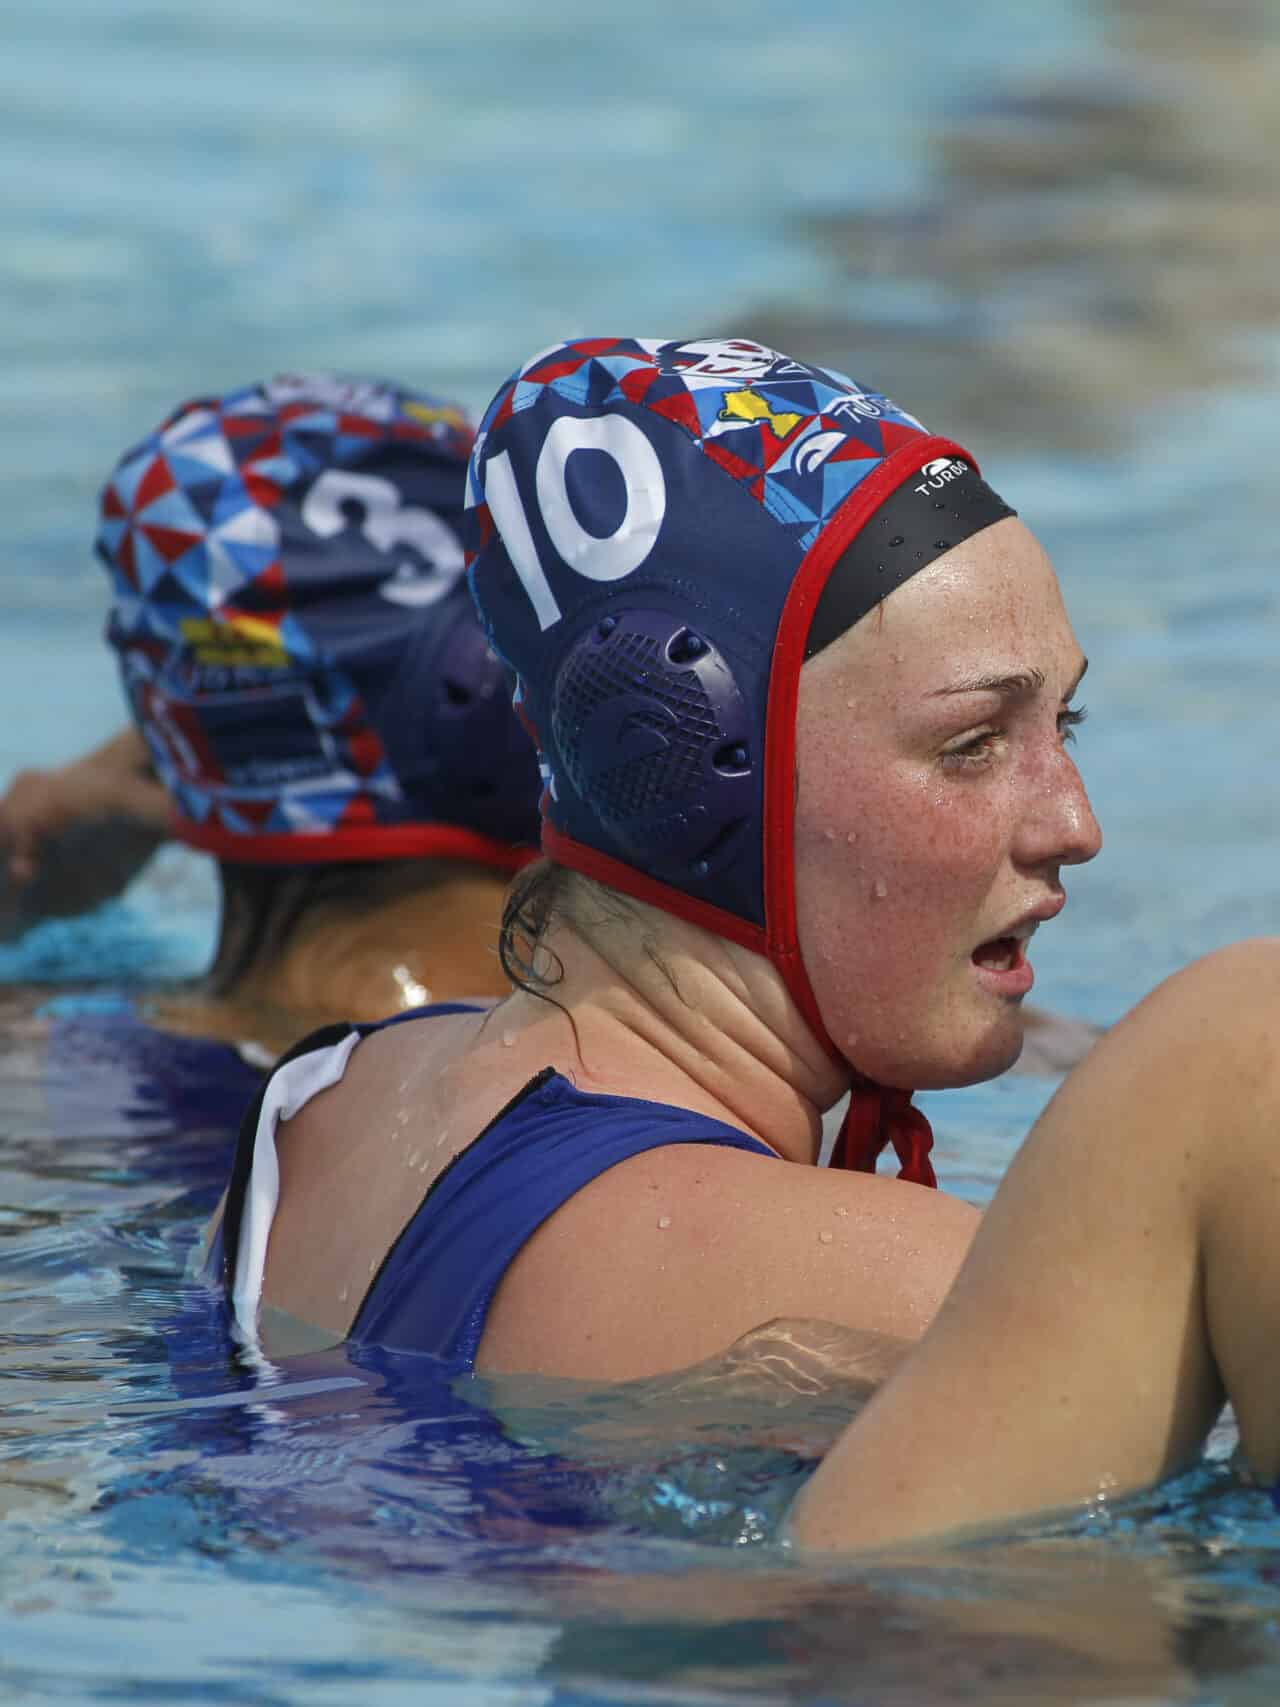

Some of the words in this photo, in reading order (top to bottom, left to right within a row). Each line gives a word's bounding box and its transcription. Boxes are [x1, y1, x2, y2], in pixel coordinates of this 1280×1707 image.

[304, 468, 466, 608] 3
[485, 413, 666, 632] 10
[915, 460, 969, 496] TURBO
